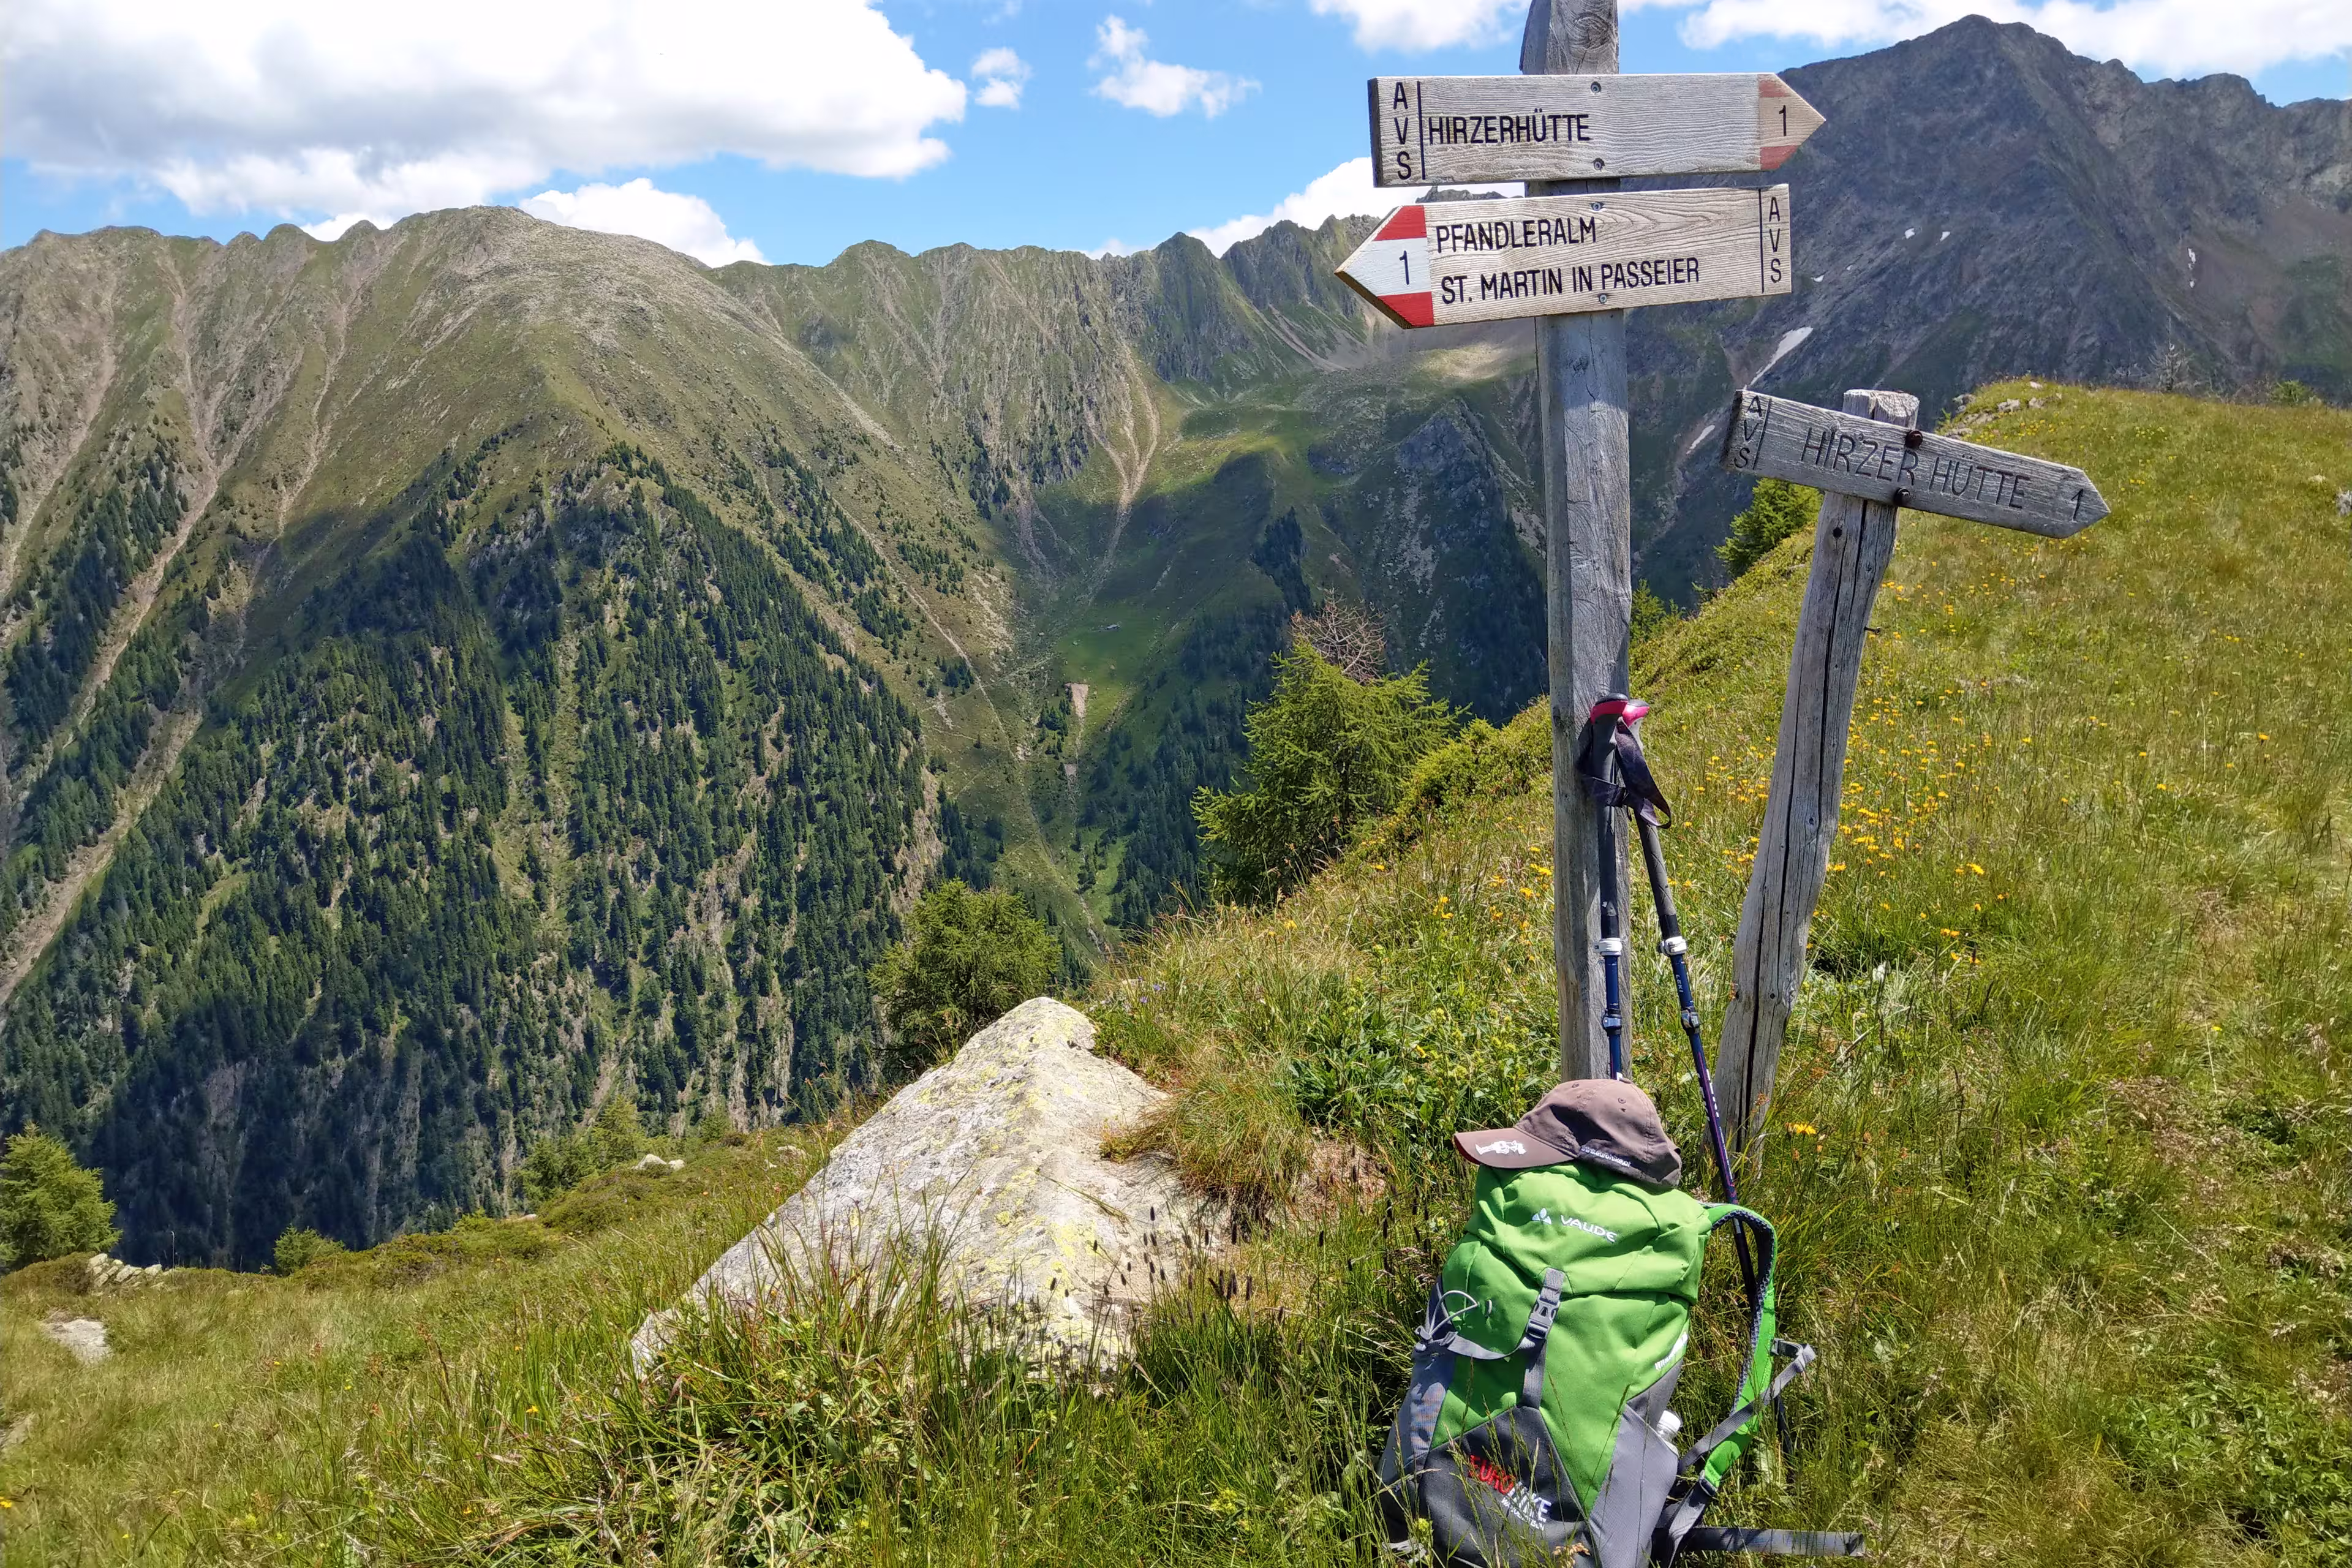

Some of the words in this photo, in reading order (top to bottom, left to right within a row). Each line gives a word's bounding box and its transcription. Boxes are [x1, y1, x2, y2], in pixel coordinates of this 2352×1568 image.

[1428, 108, 1591, 145] HIRZERHÜTTE
[1778, 105, 1788, 137] 1
[1436, 216, 1596, 253] PFANDLERALM
[1399, 251, 1410, 285] 1
[1441, 276, 1473, 304] ST.
[1480, 268, 1563, 300] MARTIN
[1572, 265, 1593, 292] IN
[1601, 257, 1700, 289] PASSEIER
[1801, 427, 1920, 486] HIRZER
[1929, 454, 2031, 509] HÜTTE
[1675, 974, 1684, 993] LEKI
[1561, 1215, 1618, 1242] VAUDE
